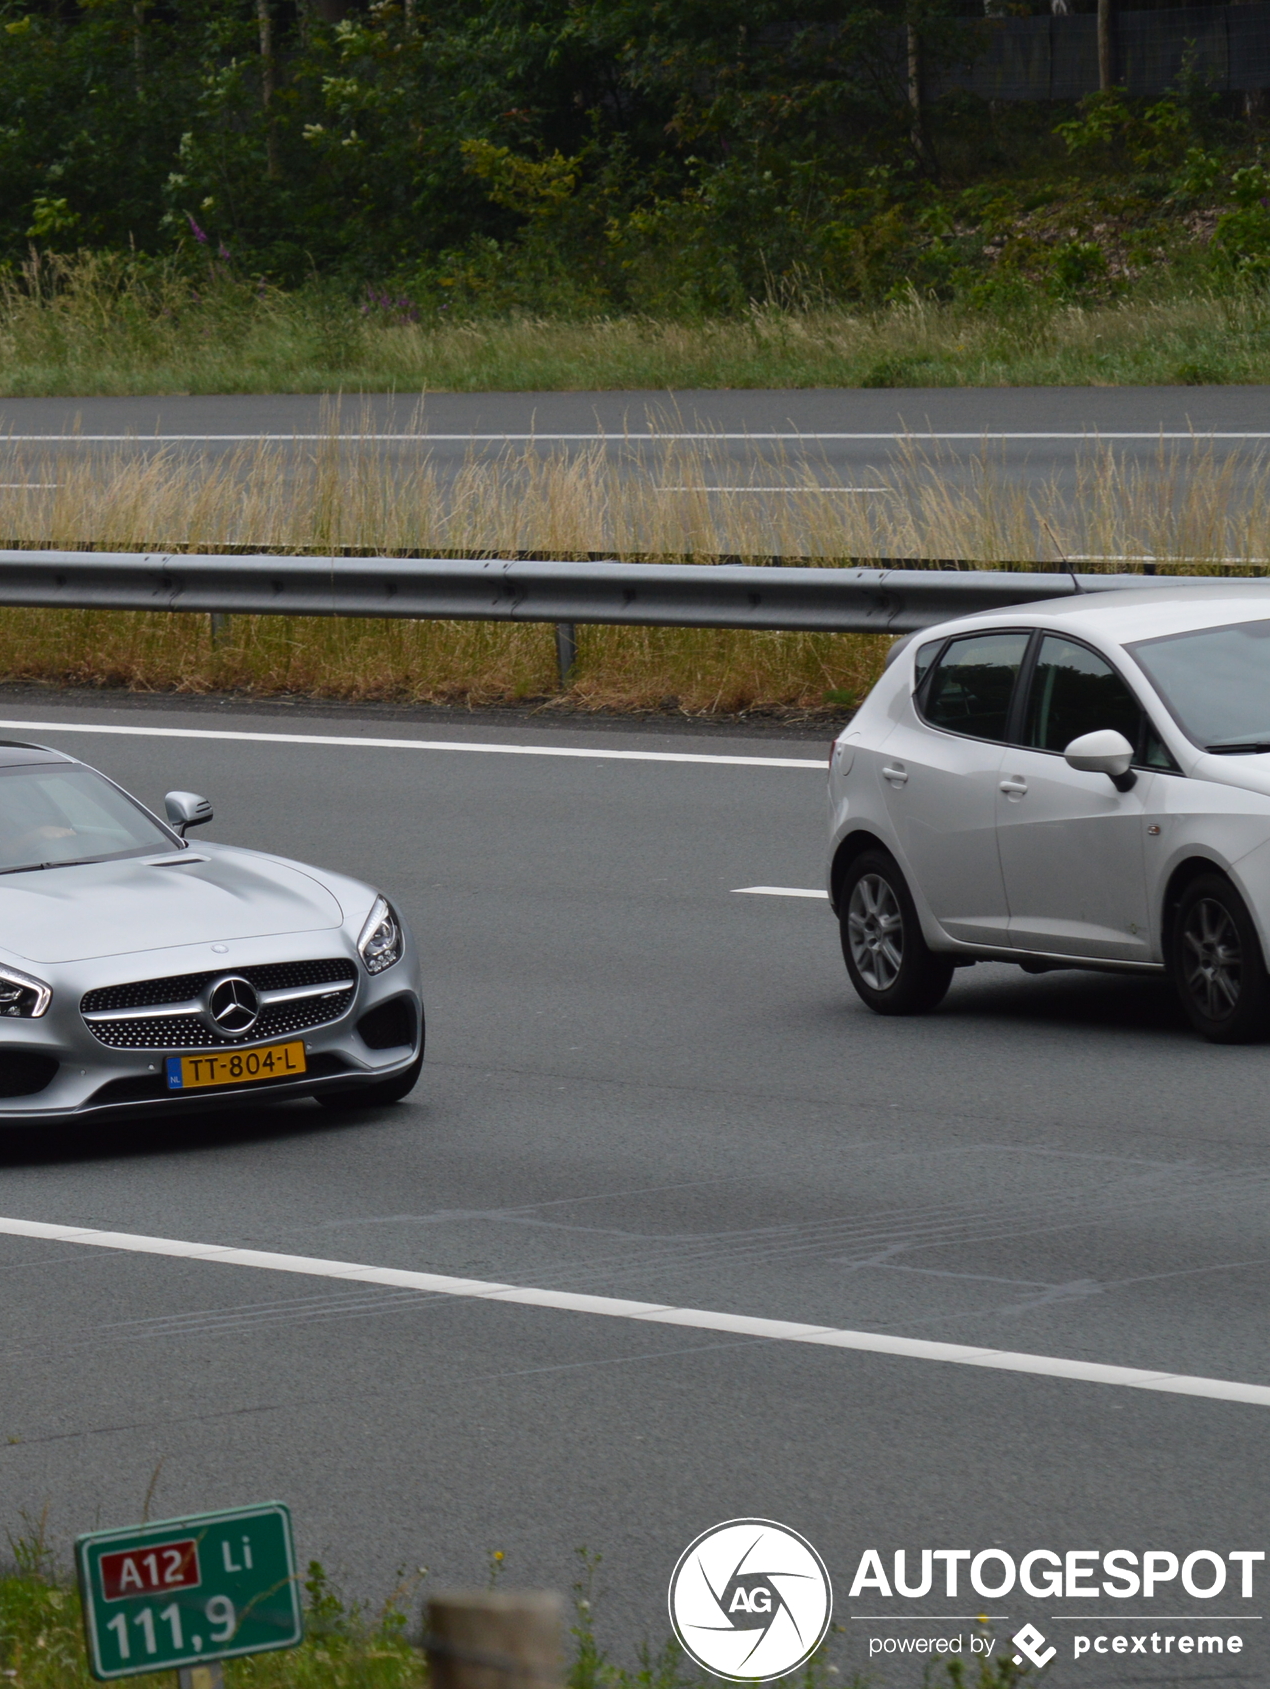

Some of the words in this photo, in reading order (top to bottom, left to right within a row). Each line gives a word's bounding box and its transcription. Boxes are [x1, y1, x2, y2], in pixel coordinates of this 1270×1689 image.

[189, 1048, 296, 1081] TT-804-L
[119, 1550, 184, 1591] A12
[222, 1536, 253, 1572] Li
[106, 1595, 236, 1659] 111,9
